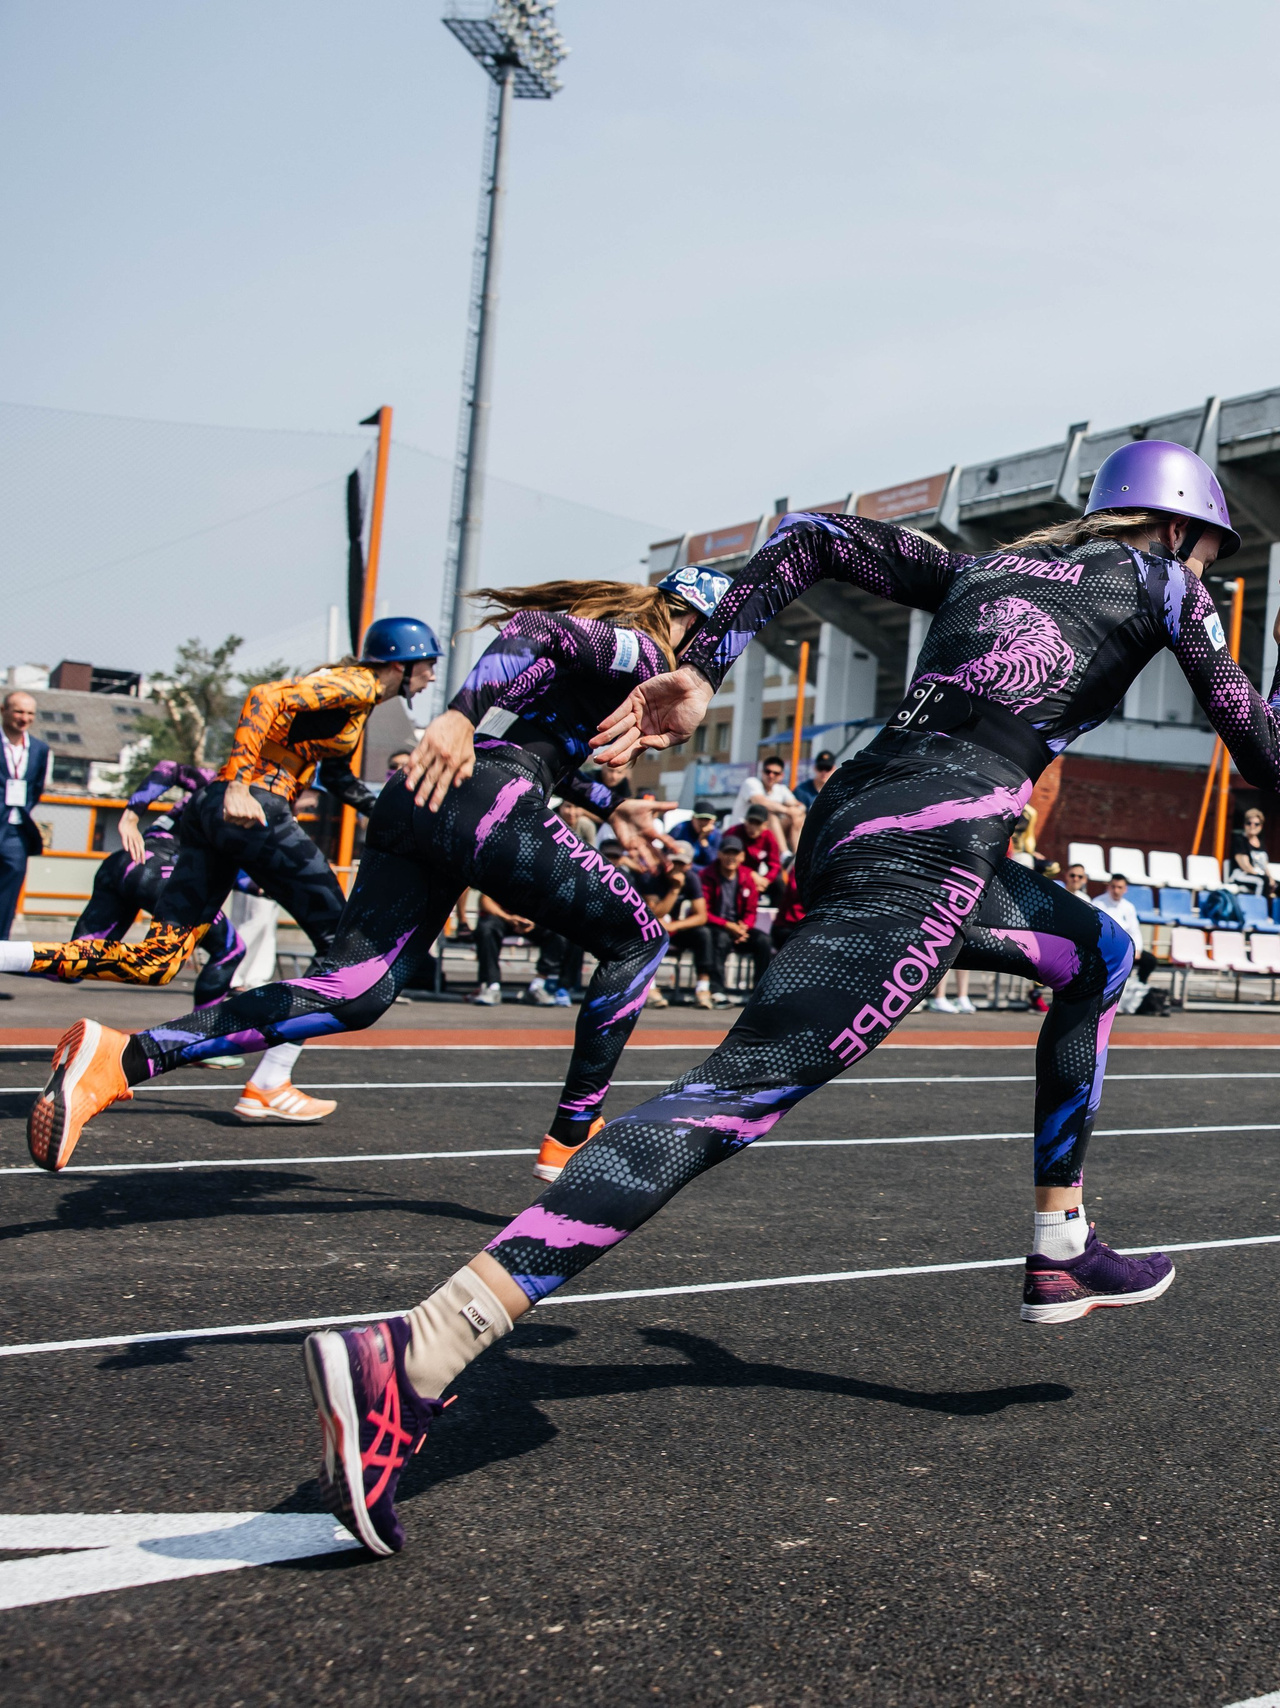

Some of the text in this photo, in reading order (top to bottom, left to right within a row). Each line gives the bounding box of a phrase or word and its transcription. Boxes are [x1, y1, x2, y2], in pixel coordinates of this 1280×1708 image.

[984, 554, 1085, 586] ГРУЛЕВА
[543, 813, 663, 942] ПРИМОРЬЕ
[828, 866, 986, 1067] ПРИМОРЬЕ
